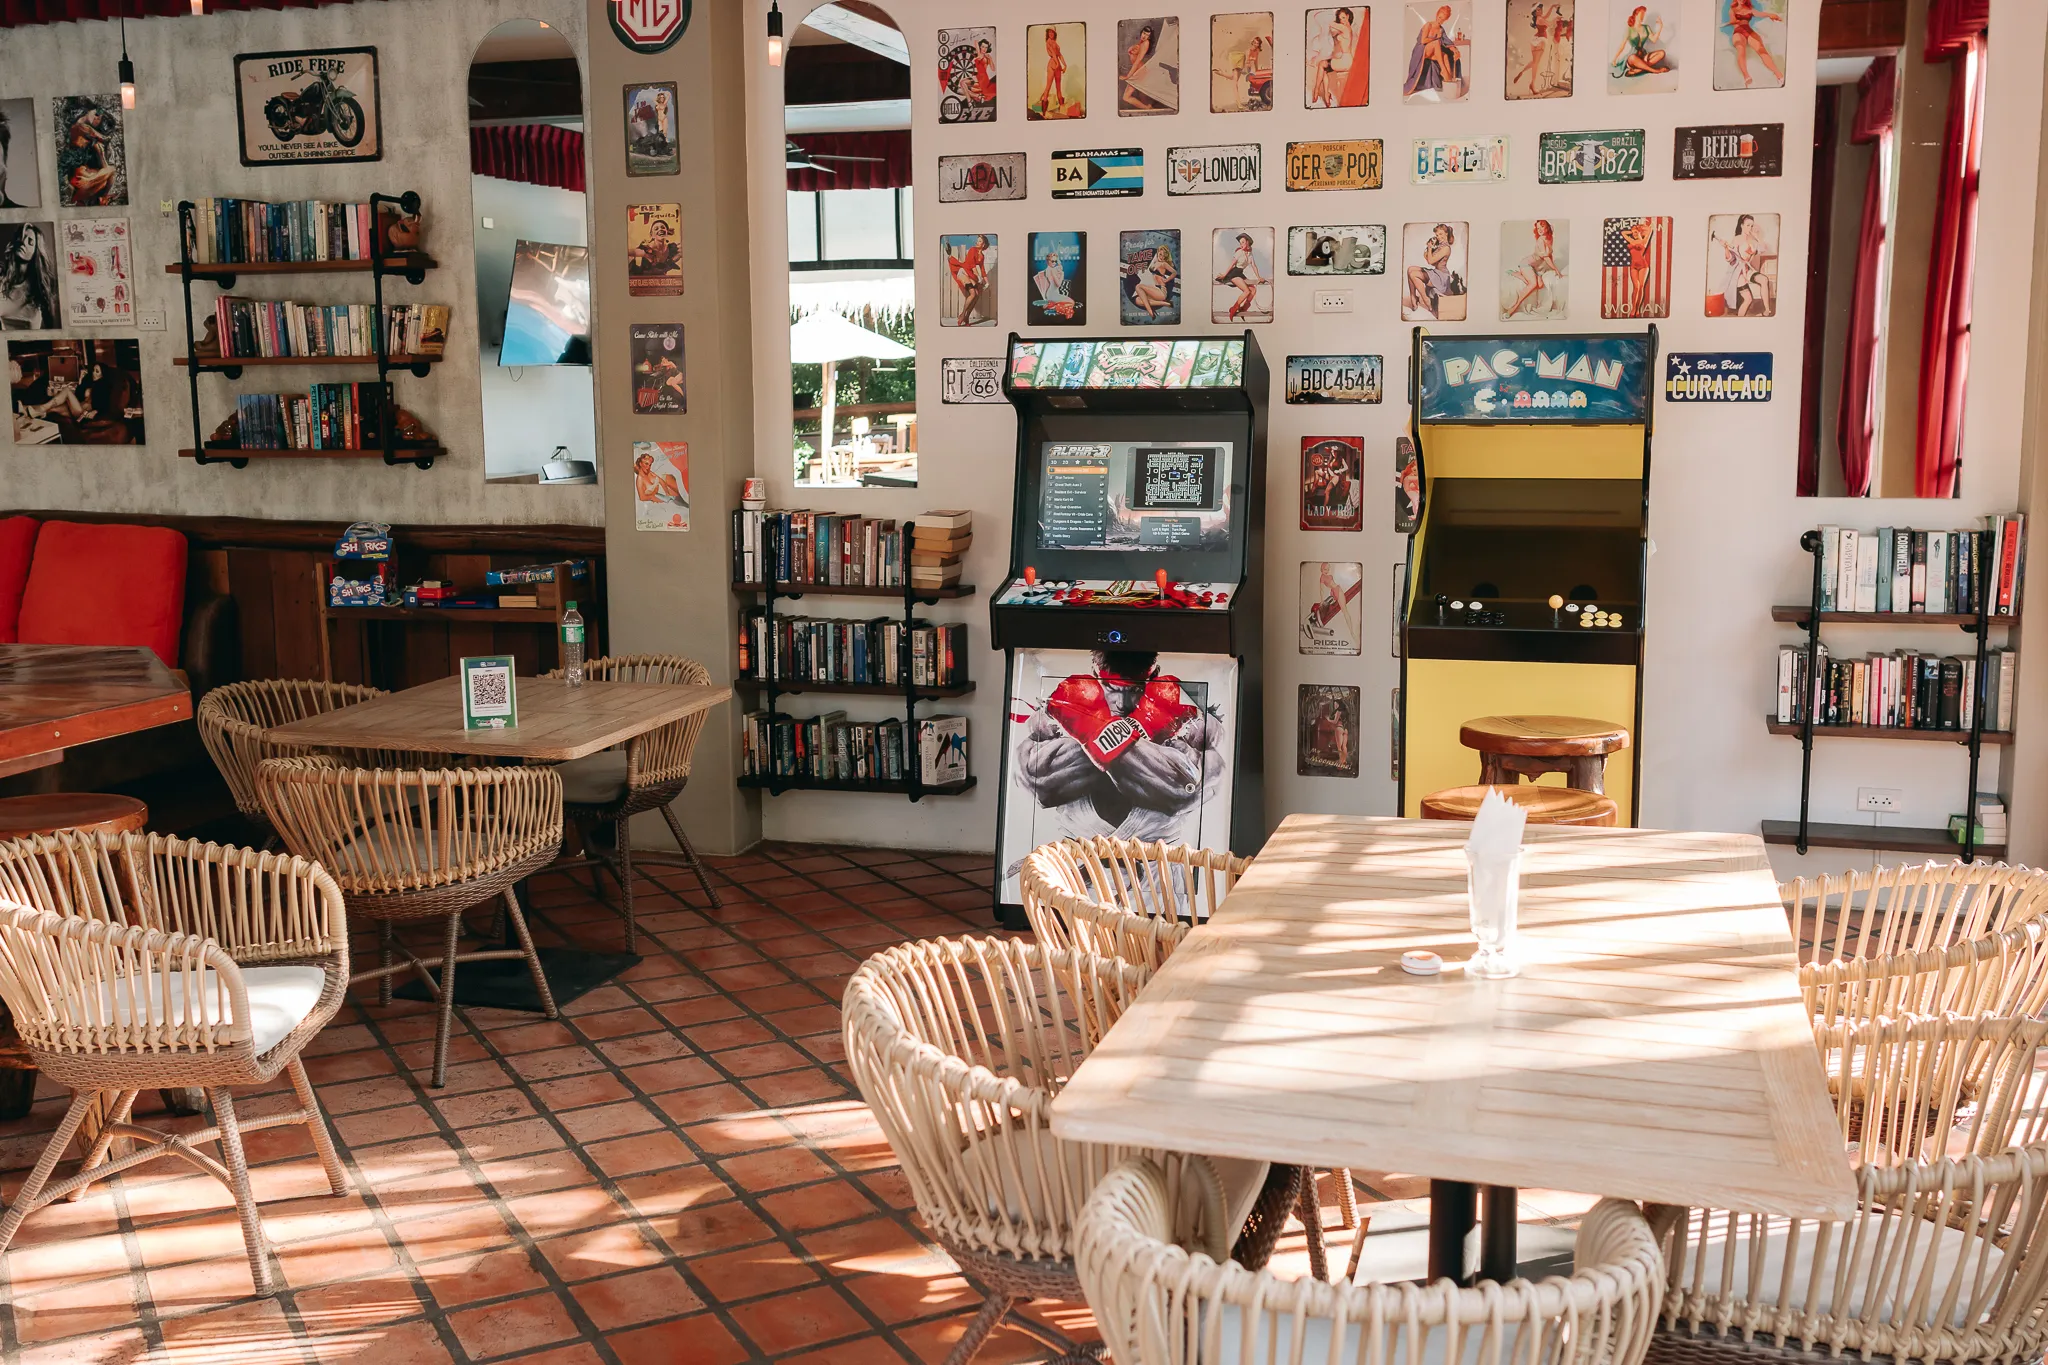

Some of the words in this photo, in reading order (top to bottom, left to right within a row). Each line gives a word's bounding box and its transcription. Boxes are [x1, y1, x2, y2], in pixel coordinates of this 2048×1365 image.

[630, 0, 670, 27] MG
[267, 59, 303, 77] RIDE
[309, 58, 346, 73] FREE
[943, 103, 960, 115] BULLS
[959, 107, 995, 121] EYE
[1546, 139, 1567, 149] JESUS
[1611, 136, 1638, 146] BRAZIL
[1702, 135, 1738, 158] BEER
[1291, 154, 1321, 181] GER
[1347, 152, 1378, 179] POR
[1417, 145, 1504, 175] BERLIN
[1545, 150, 1578, 176] BRA
[1600, 148, 1640, 175] 1822
[1699, 156, 1755, 174] Brewery
[952, 166, 1013, 191] JAPAN
[1057, 166, 1083, 182] BA
[1171, 159, 1177, 184] I
[1203, 156, 1257, 182] LONDON
[1050, 239, 1079, 257] Vegas
[1127, 249, 1153, 263] TAKE
[1127, 262, 1149, 275] OFF
[1604, 303, 1665, 315] WOAN
[1443, 349, 1624, 390] PAC-MAN
[1697, 360, 1718, 371] Bon
[1720, 360, 1744, 371] Bini
[946, 369, 966, 394] RT
[975, 380, 994, 394] 66
[1671, 373, 1768, 402] CURAÇAO
[1307, 503, 1331, 517] LADY
[1844, 543, 1853, 573] CAPITAL
[1897, 535, 1909, 572] CORNWELL
[1314, 639, 1349, 647] RIDGID
[1310, 756, 1352, 770] Moonshine!
